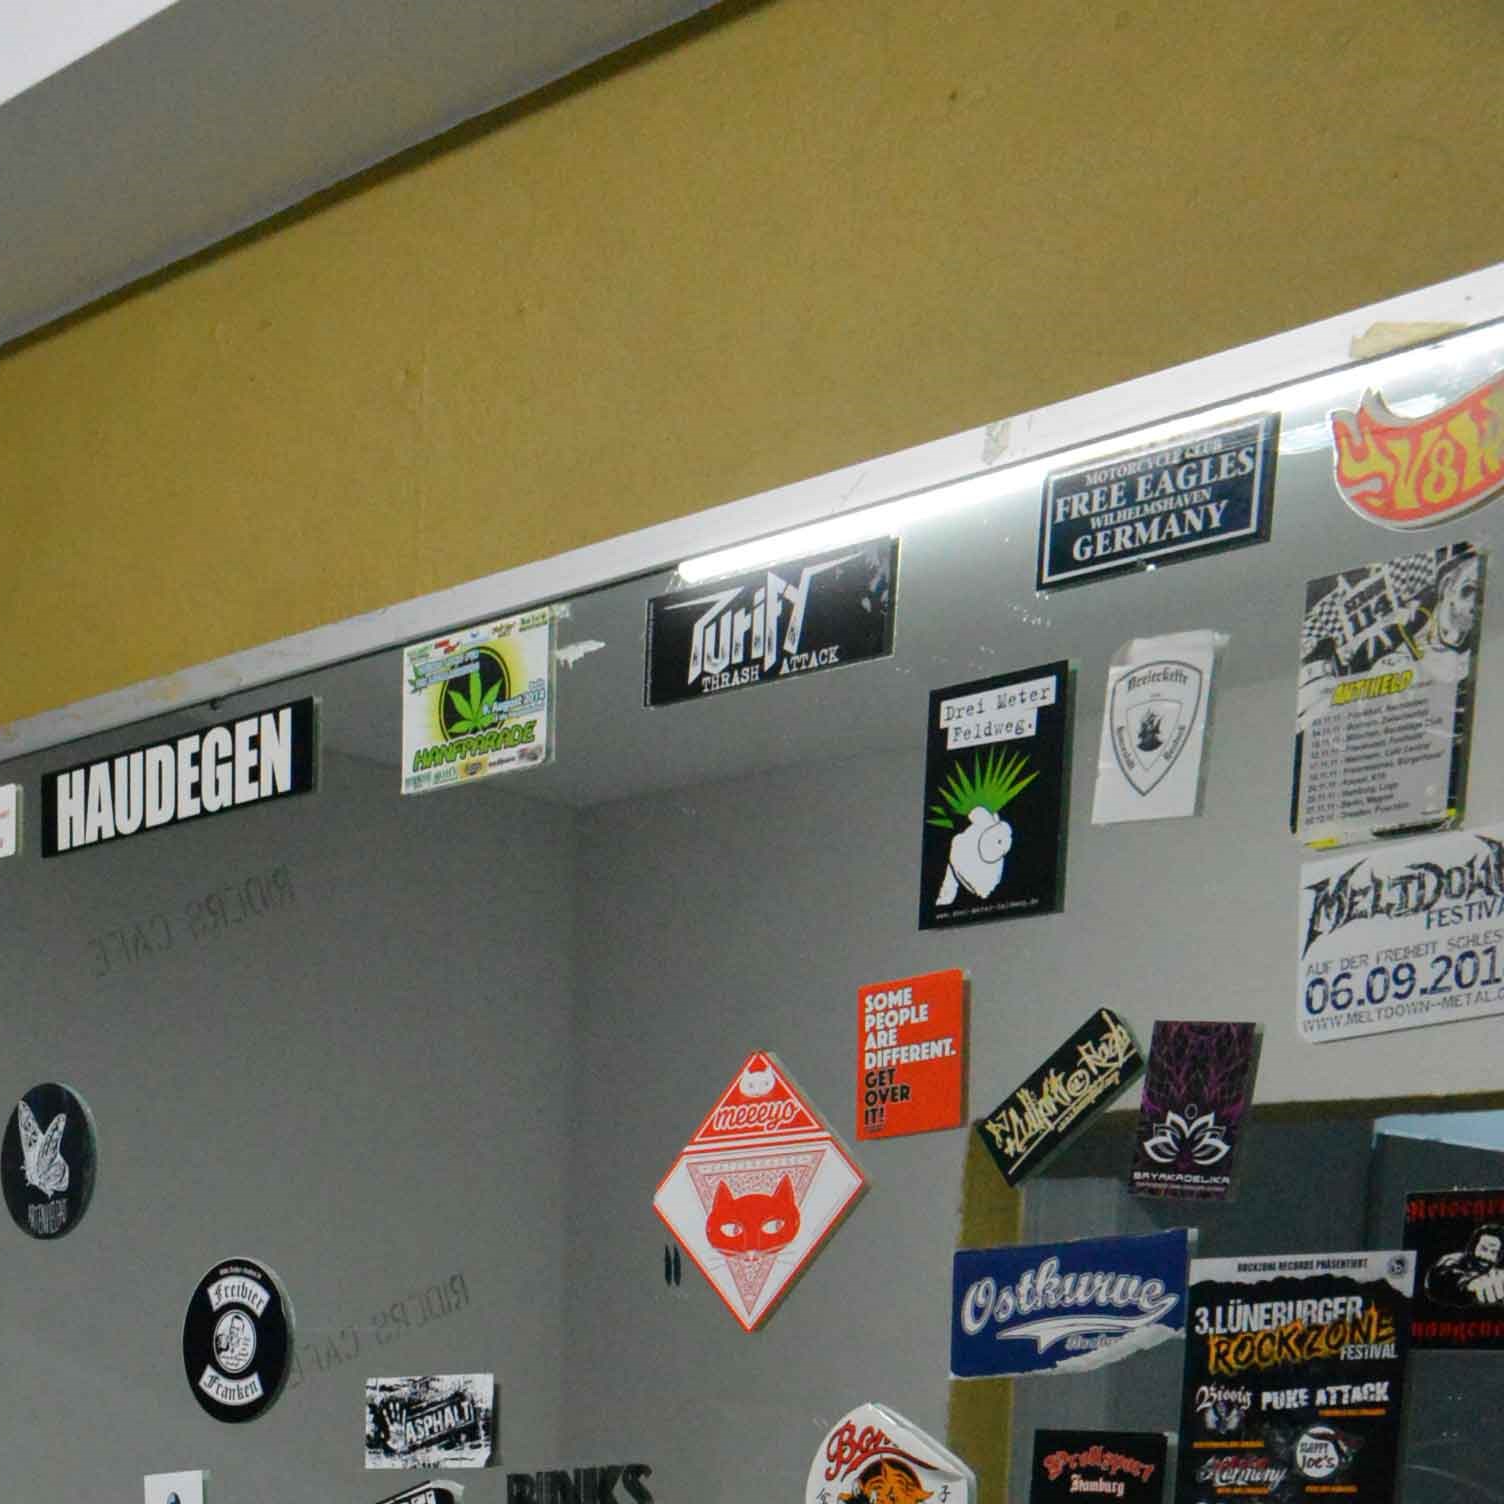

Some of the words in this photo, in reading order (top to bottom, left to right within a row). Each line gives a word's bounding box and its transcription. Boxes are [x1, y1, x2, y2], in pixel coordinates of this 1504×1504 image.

[1054, 480, 1128, 524] FREE
[1136, 447, 1255, 502] EAGLES
[1090, 486, 1214, 530] WILHELMSHAVEN
[1072, 499, 1230, 562] GERMANY
[702, 666, 761, 694] THRASH
[779, 644, 841, 676] ATTACK
[943, 699, 986, 722] Drei
[996, 685, 1052, 711] Meter
[952, 717, 1035, 744] Feldweg.
[412, 720, 539, 773] HANFPARADE
[56, 706, 293, 853] HAUDEGEN
[1340, 954, 1370, 971] DER
[865, 987, 913, 1013] SOME
[865, 1003, 929, 1032] PEOPLE
[865, 1028, 899, 1050] ARE
[865, 1038, 957, 1070] DIFFERENT.
[865, 1069, 896, 1089] GET
[865, 1085, 911, 1107] OVER
[864, 1107, 885, 1125] IT!
[960, 1256, 1180, 1335] Ostkurve
[1340, 1344, 1398, 1361] FESTIVAL
[202, 1373, 260, 1402] Franken
[1261, 1388, 1310, 1411] PUKE
[1316, 1381, 1391, 1408] ATTACK
[404, 1401, 473, 1447] ASPHALT
[1069, 1474, 1126, 1497] Hamburg
